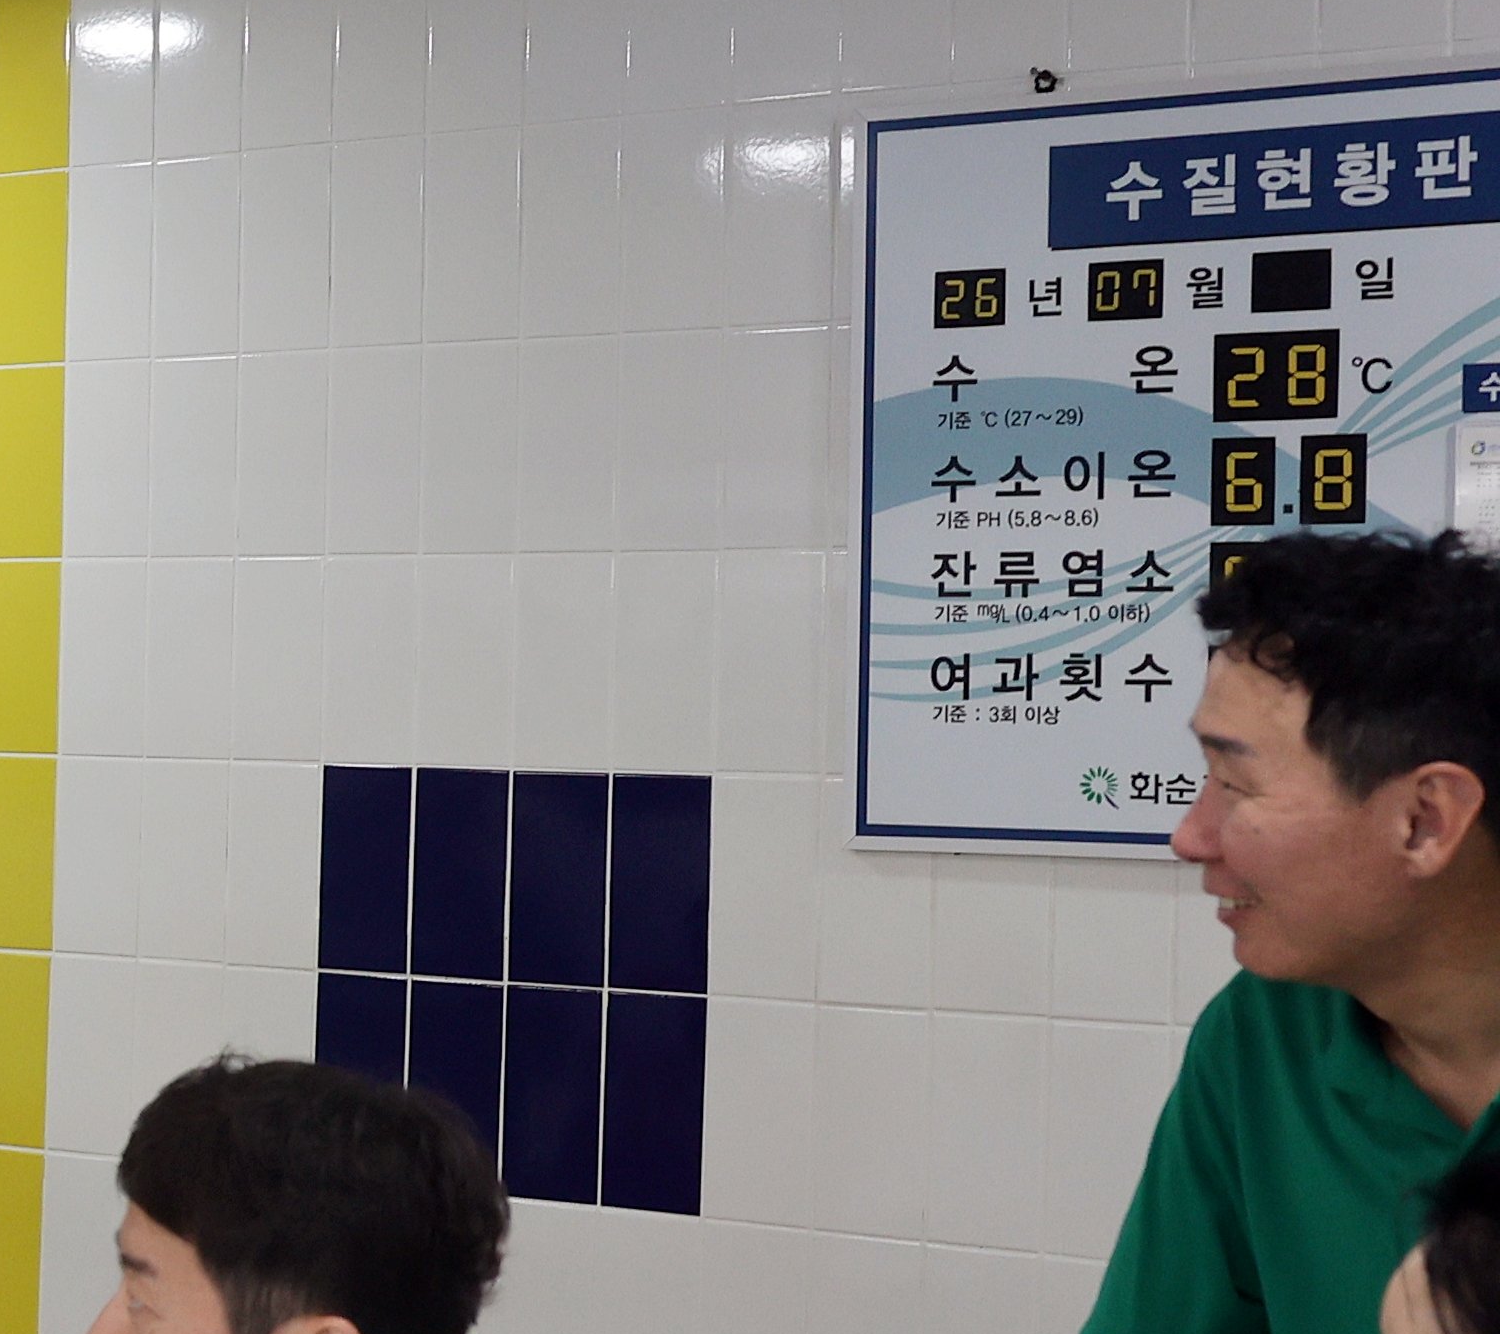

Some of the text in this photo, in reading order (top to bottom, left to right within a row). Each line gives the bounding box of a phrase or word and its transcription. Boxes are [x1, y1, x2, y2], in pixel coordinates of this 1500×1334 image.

[1105, 134, 1479, 222] 수질현황판
[940, 277, 998, 321] 26
[1028, 276, 1062, 318] 년
[1186, 266, 1225, 310] 월
[1355, 256, 1394, 301] 일
[1226, 343, 1327, 409] 28
[937, 409, 972, 430] 기준
[935, 510, 973, 530] 기준
[976, 510, 1002, 528] PH
[933, 605, 969, 623] 기준
[932, 704, 968, 725] 기준
[988, 704, 1018, 725] 3회
[1024, 704, 1061, 726] 이상
[1128, 772, 1209, 805] 화순
